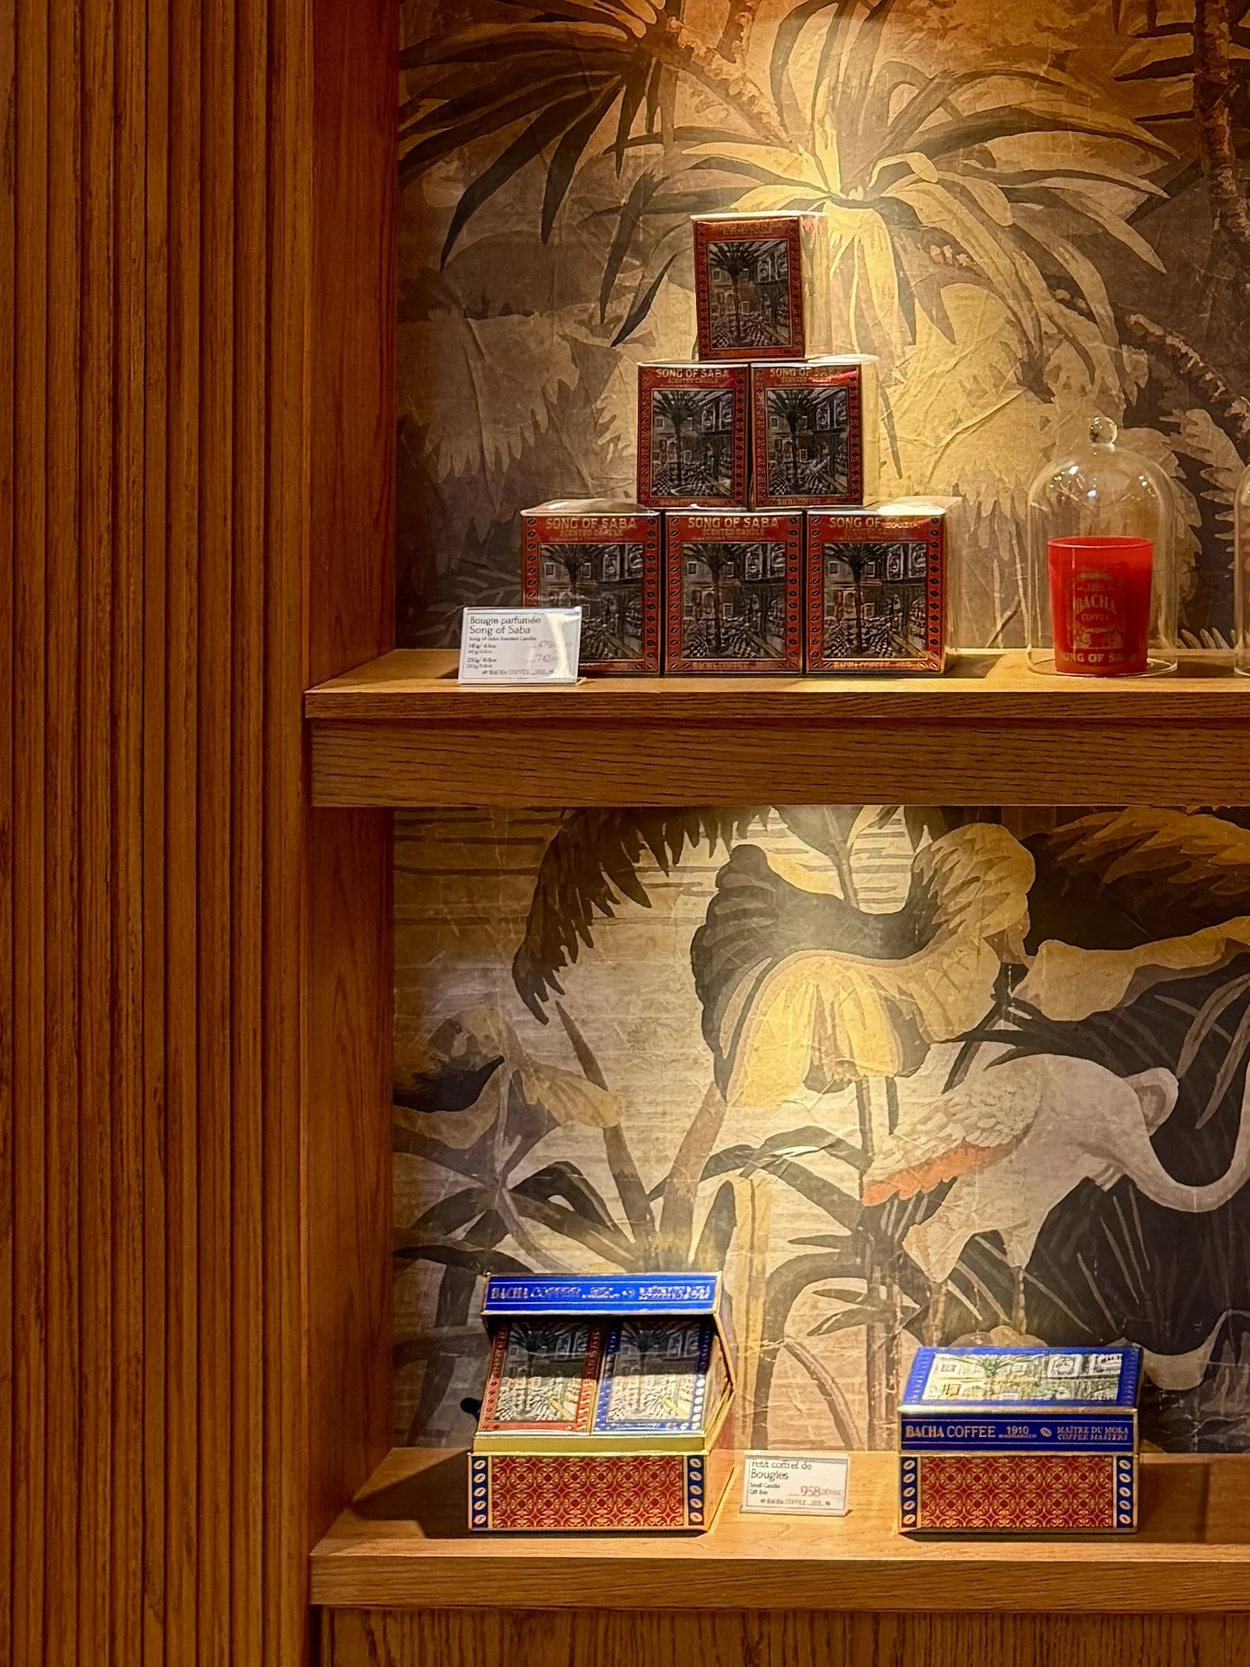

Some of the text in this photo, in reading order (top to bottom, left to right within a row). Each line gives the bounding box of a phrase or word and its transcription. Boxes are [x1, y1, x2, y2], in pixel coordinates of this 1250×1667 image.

[656, 369, 729, 378] SONG OF SABA
[770, 368, 796, 378] SONG
[546, 518, 637, 529] SONG OF SABA
[688, 518, 779, 529] SONG OF SABA
[829, 518, 861, 528] SONG
[865, 518, 881, 528] OF
[470, 616, 499, 626] Bougie
[469, 625, 531, 636] Song of Saba
[1088, 653, 1105, 662] OF
[905, 1425, 945, 1438] BACHA
[946, 1425, 996, 1438] COFFEE
[1006, 1425, 1029, 1435] 1910
[1091, 1426, 1103, 1434] DU
[1104, 1426, 1129, 1434] MOKA
